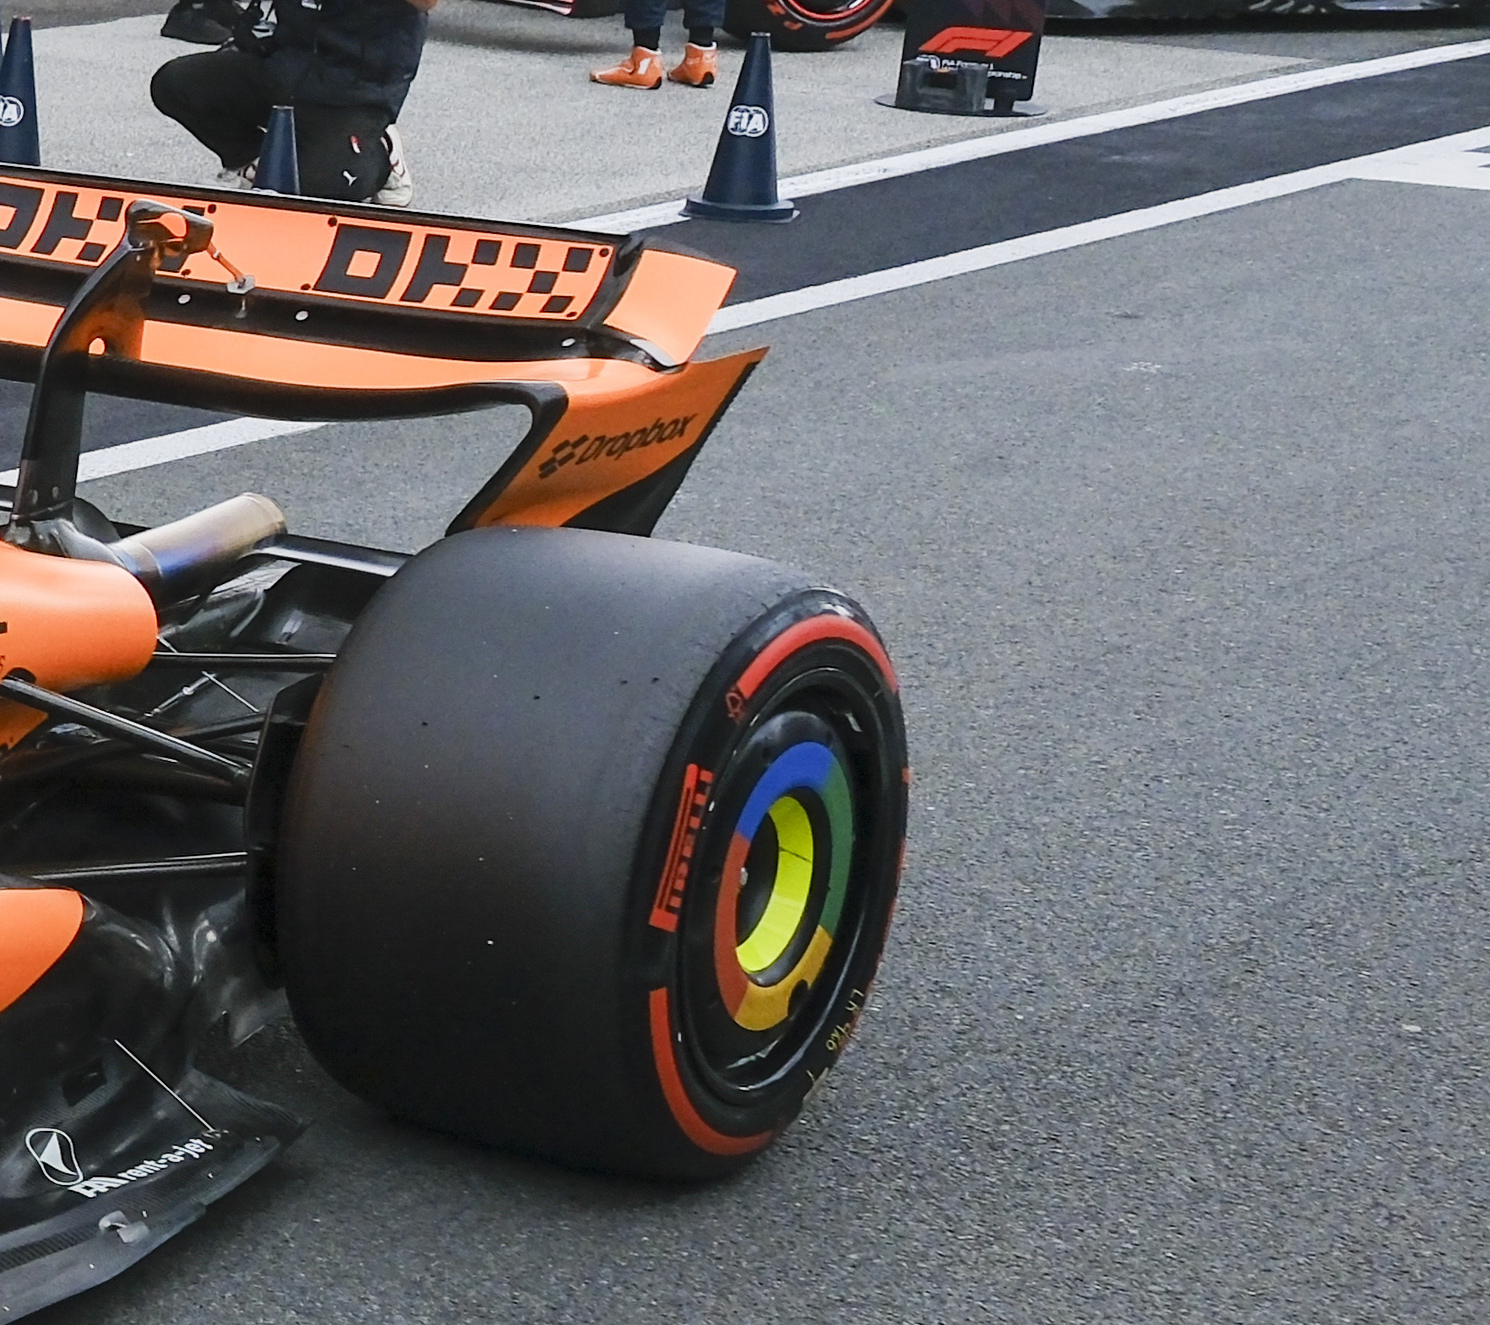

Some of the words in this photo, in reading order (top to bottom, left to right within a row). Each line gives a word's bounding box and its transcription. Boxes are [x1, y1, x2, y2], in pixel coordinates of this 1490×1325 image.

[918, 25, 1033, 59] F1
[727, 112, 767, 136] FIA
[314, 222, 593, 315] OKX
[574, 411, 698, 467] Dropbox
